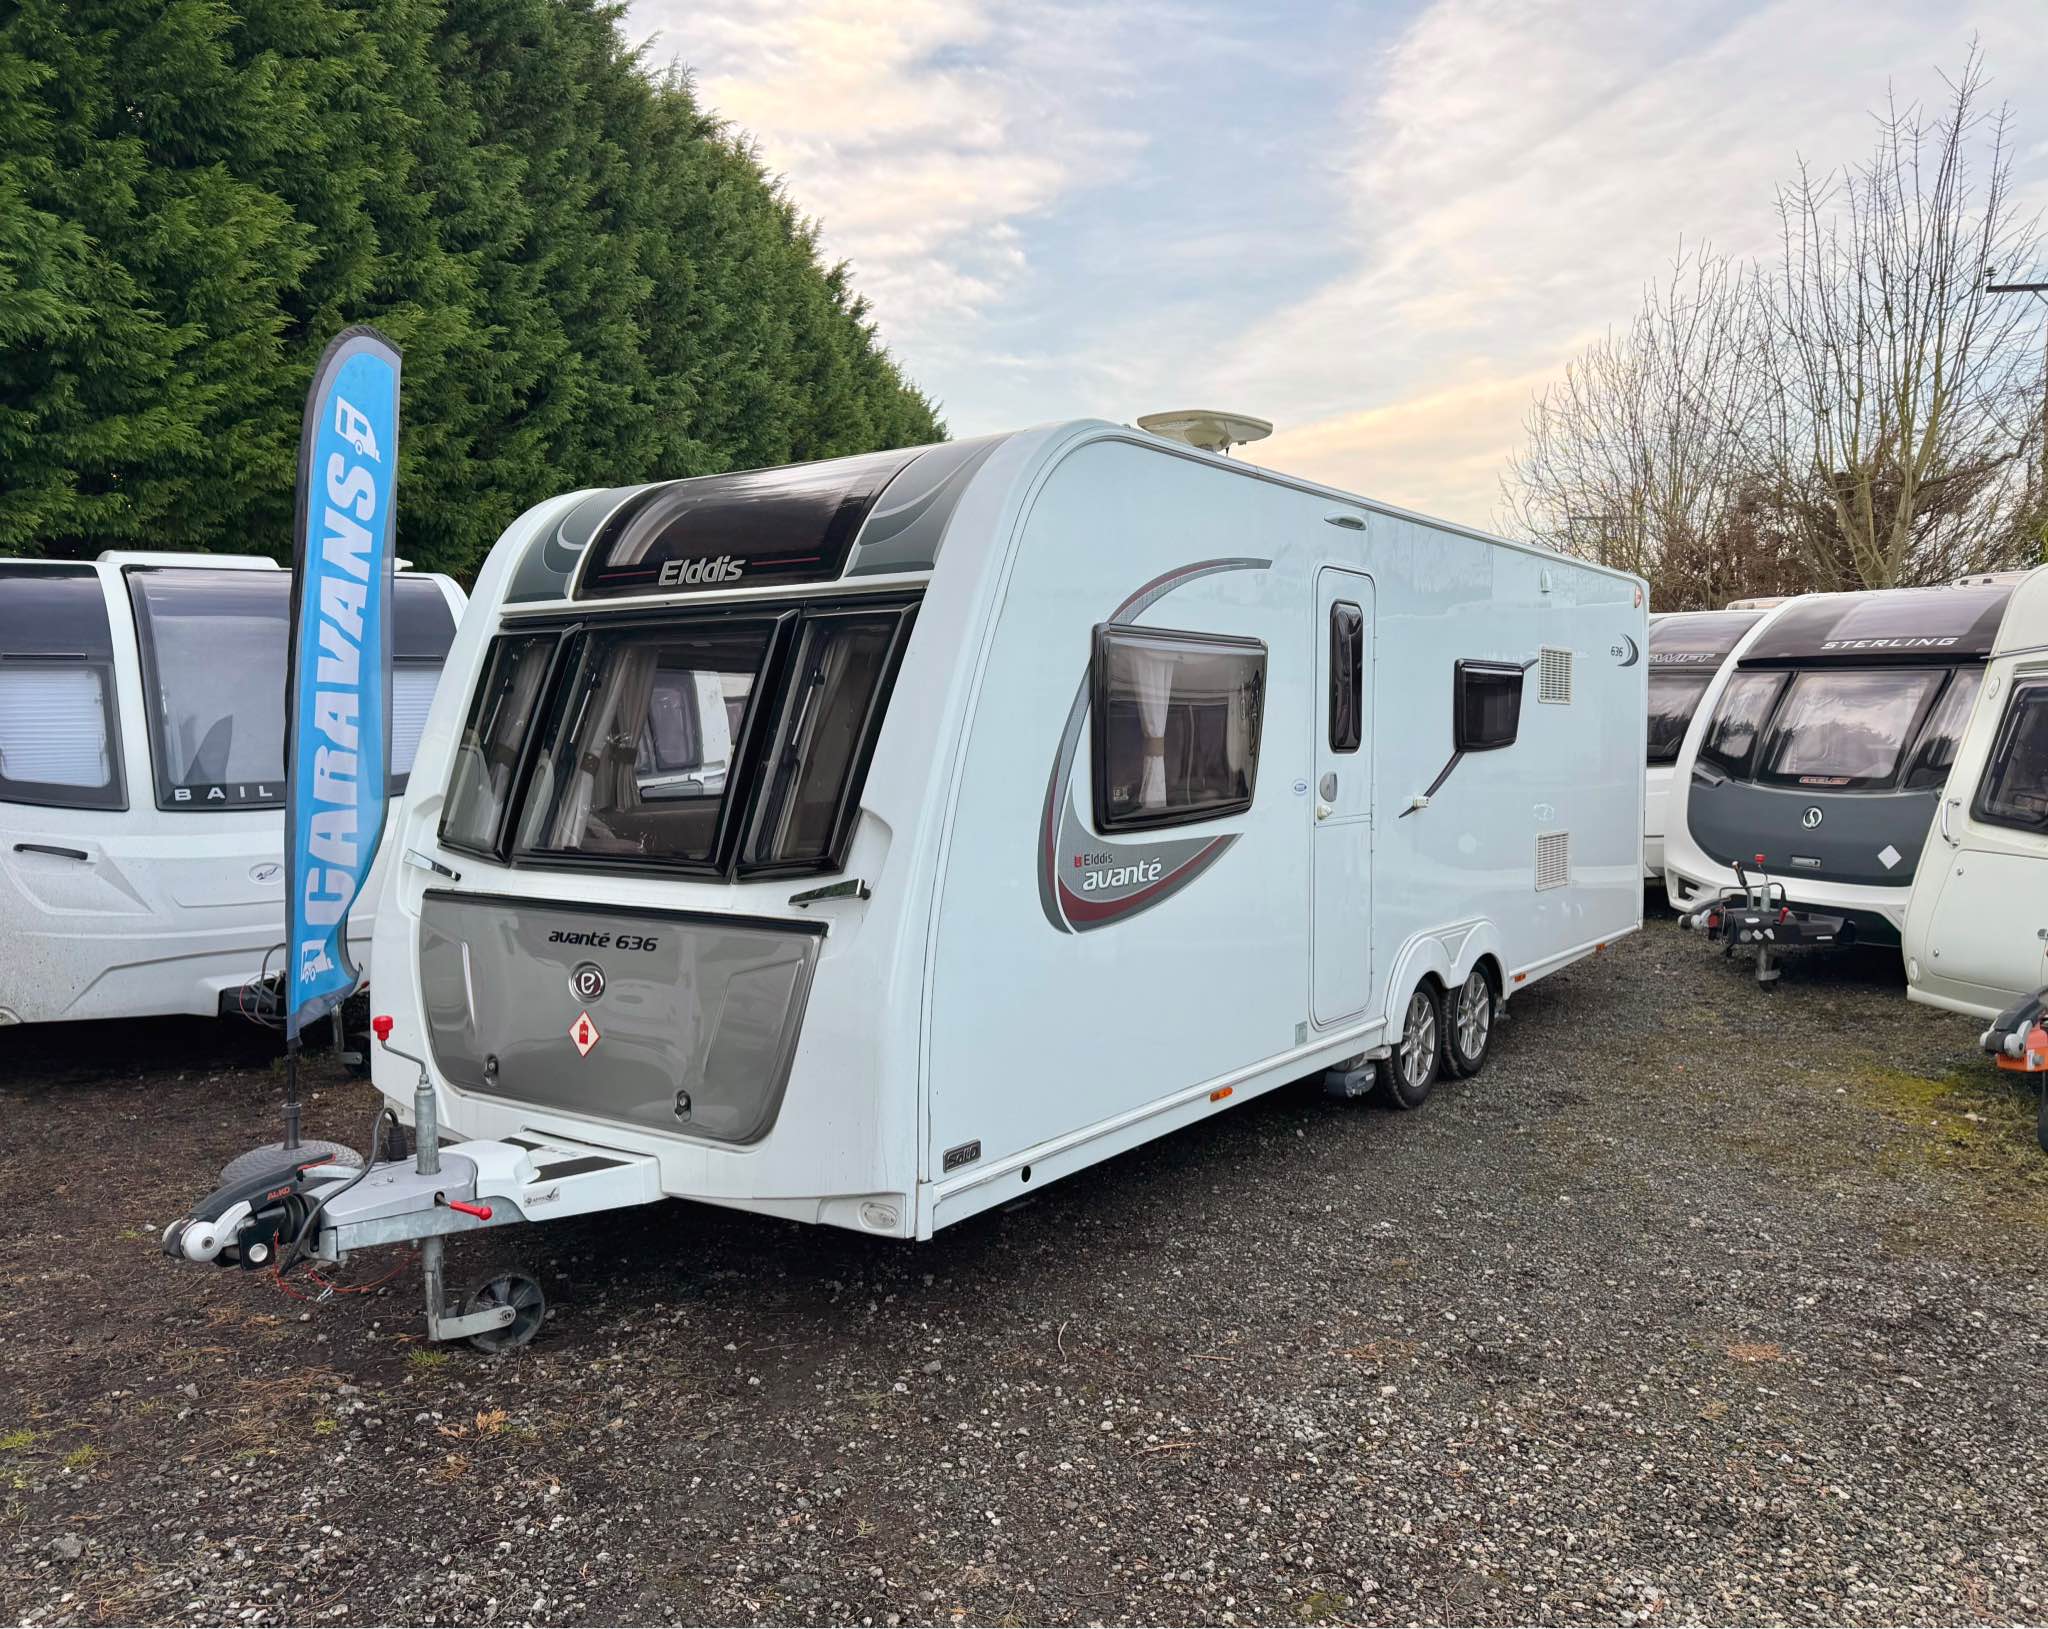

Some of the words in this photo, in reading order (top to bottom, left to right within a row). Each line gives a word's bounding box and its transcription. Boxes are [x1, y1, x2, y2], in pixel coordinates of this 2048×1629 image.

[658, 555, 747, 586] Elddis
[1610, 646, 1624, 657] 636
[1820, 637, 1960, 650] STERLING
[305, 452, 376, 926] CARAVANS
[174, 785, 273, 802] BAIL
[1083, 852, 1114, 866] Elddis
[1082, 857, 1162, 891] avanté
[548, 930, 611, 948] avanté
[615, 935, 659, 952] 636
